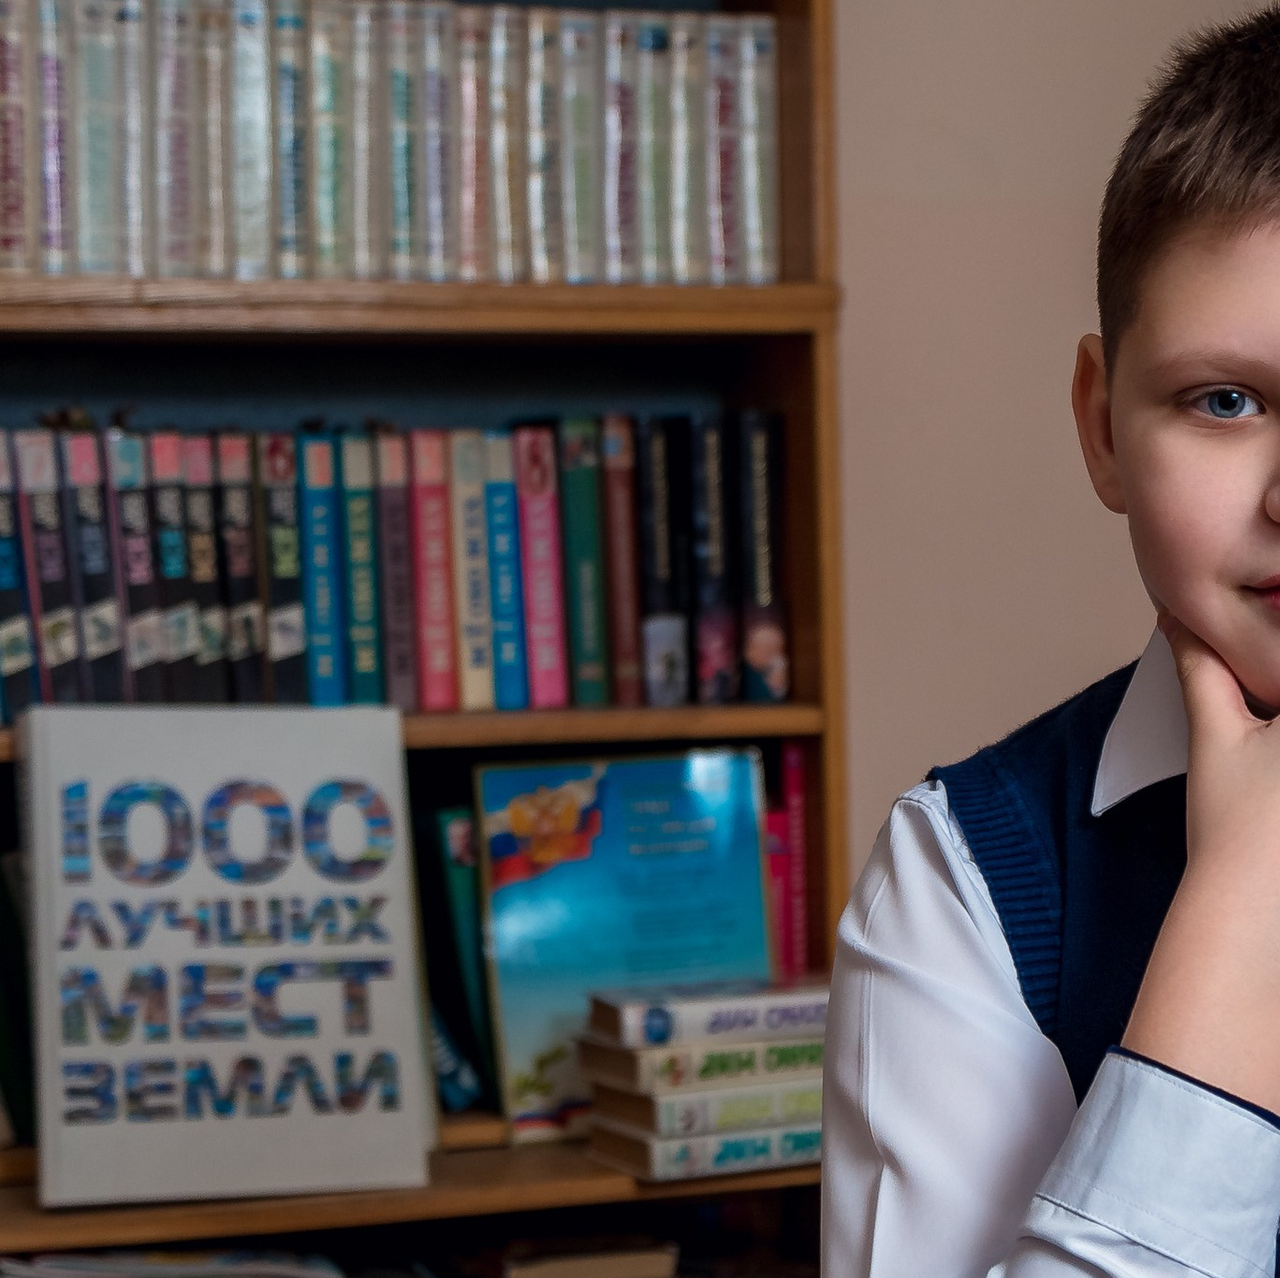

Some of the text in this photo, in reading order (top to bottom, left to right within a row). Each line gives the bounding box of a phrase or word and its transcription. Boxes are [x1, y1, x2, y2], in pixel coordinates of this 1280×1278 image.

[60, 779, 395, 887] 1000
[59, 897, 391, 951] ЛУЧШИХ
[60, 959, 395, 1047] МЕСТ
[62, 1050, 401, 1125] ЗЕМЛИ
